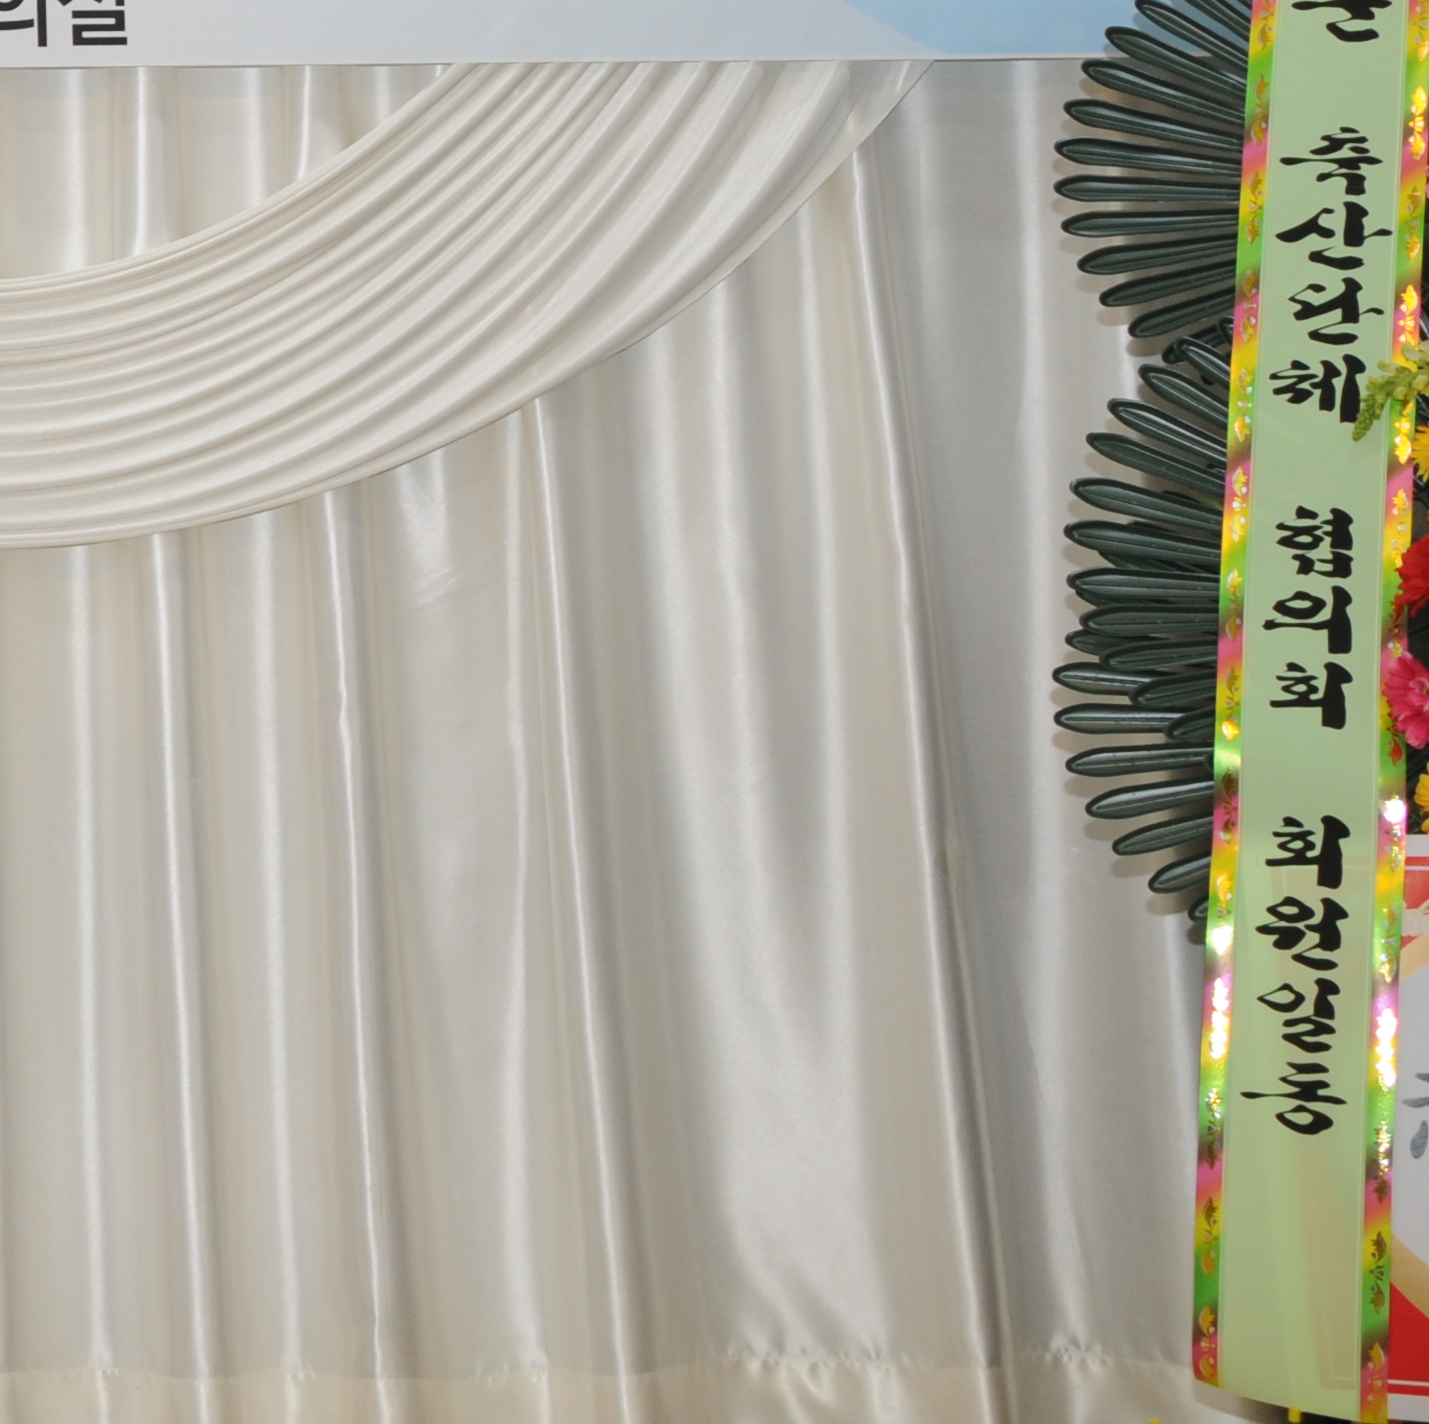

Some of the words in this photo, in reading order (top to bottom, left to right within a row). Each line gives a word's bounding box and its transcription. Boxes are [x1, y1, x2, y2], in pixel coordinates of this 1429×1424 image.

[1269, 126, 1393, 425] 축산단체
[1262, 505, 1354, 730] 협의회
[1240, 814, 1350, 1136] 회원일동
